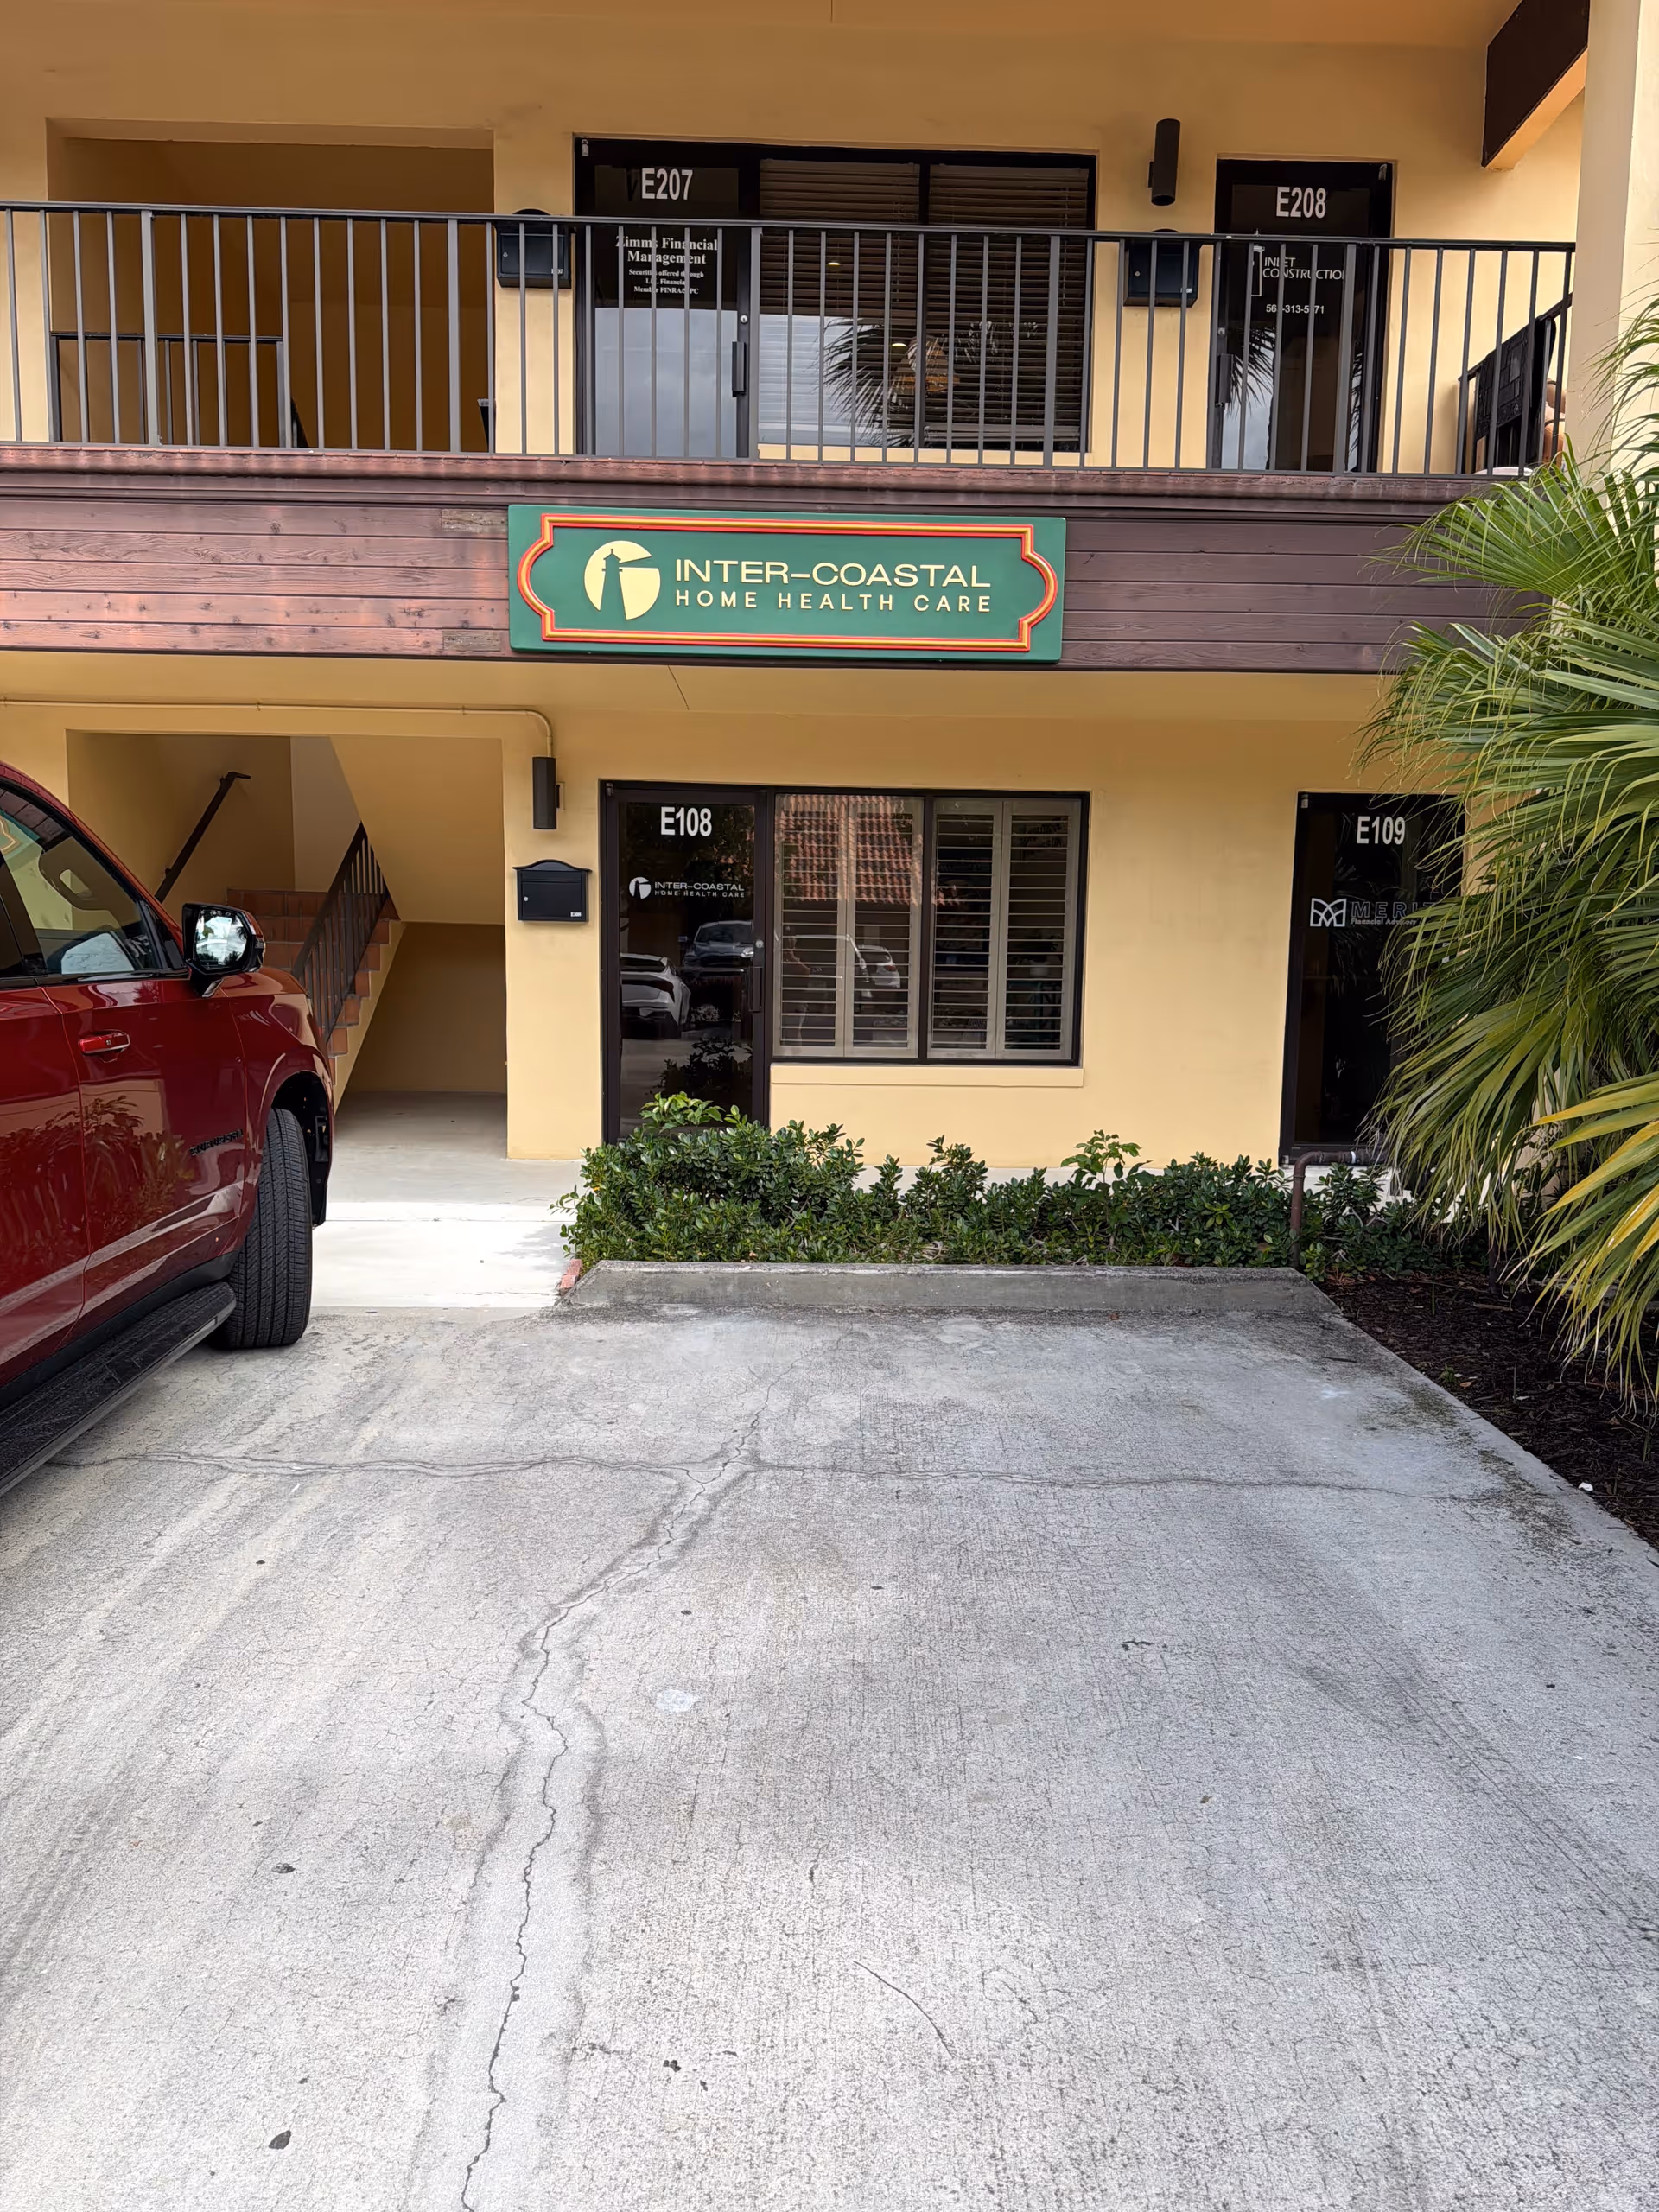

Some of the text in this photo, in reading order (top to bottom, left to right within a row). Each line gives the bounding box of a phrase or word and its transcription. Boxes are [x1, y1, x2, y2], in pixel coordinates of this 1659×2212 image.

[642, 168, 693, 200] E207
[1276, 186, 1326, 219] E208
[1266, 304, 1325, 315] 56-313-571
[675, 558, 991, 588] INTER-COASTAL
[675, 589, 991, 613] HOME HEALTH CARE
[660, 806, 713, 837] E108
[1356, 815, 1406, 845] E109
[654, 881, 745, 892] INTER-COASTAL
